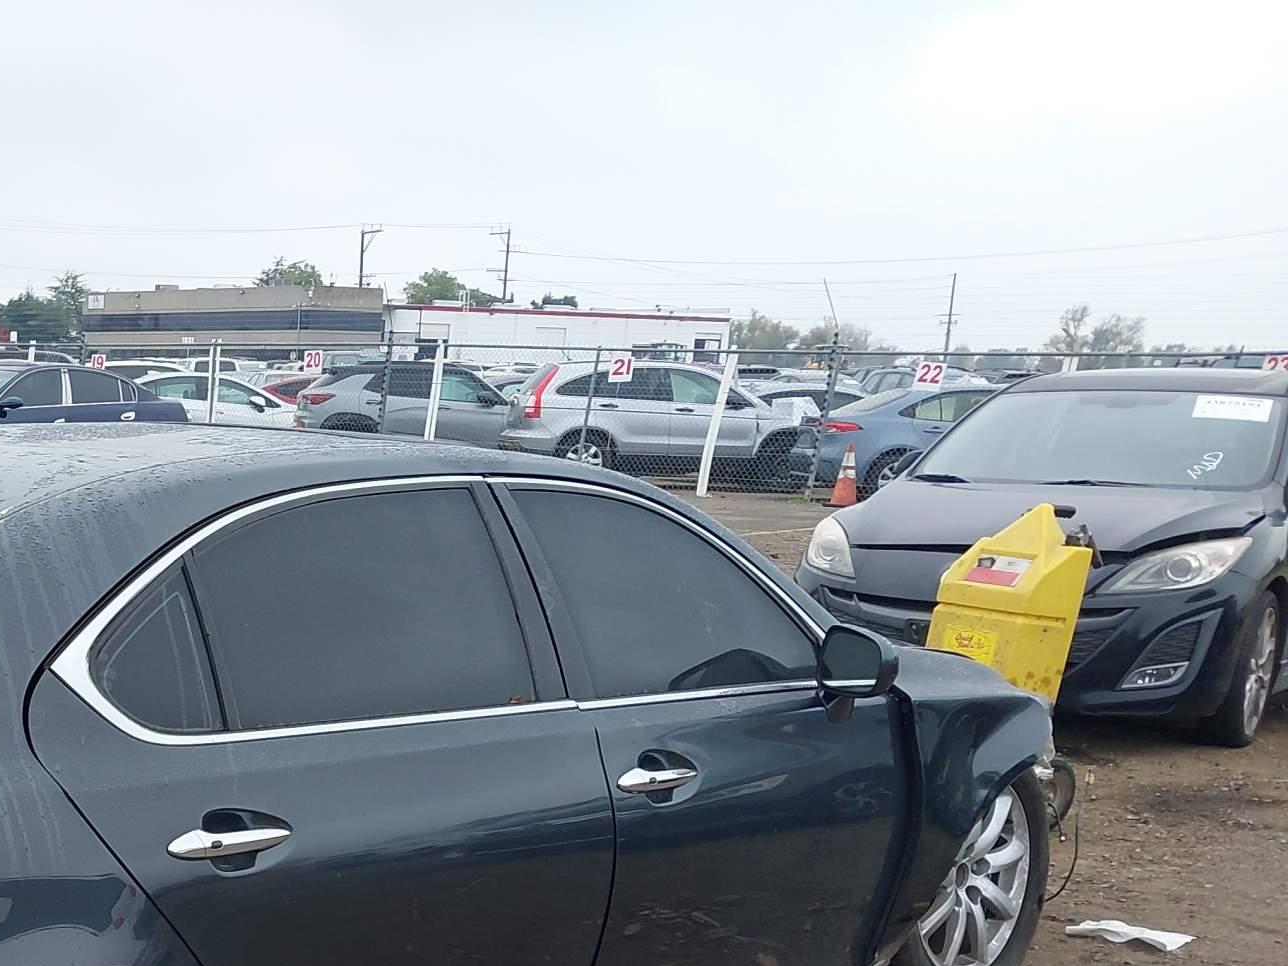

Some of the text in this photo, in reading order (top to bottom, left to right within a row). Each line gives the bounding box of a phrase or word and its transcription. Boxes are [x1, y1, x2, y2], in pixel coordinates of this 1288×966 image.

[92, 355, 104, 368] 19
[305, 352, 322, 369] 20
[611, 358, 632, 376] 21
[917, 363, 944, 385] 22
